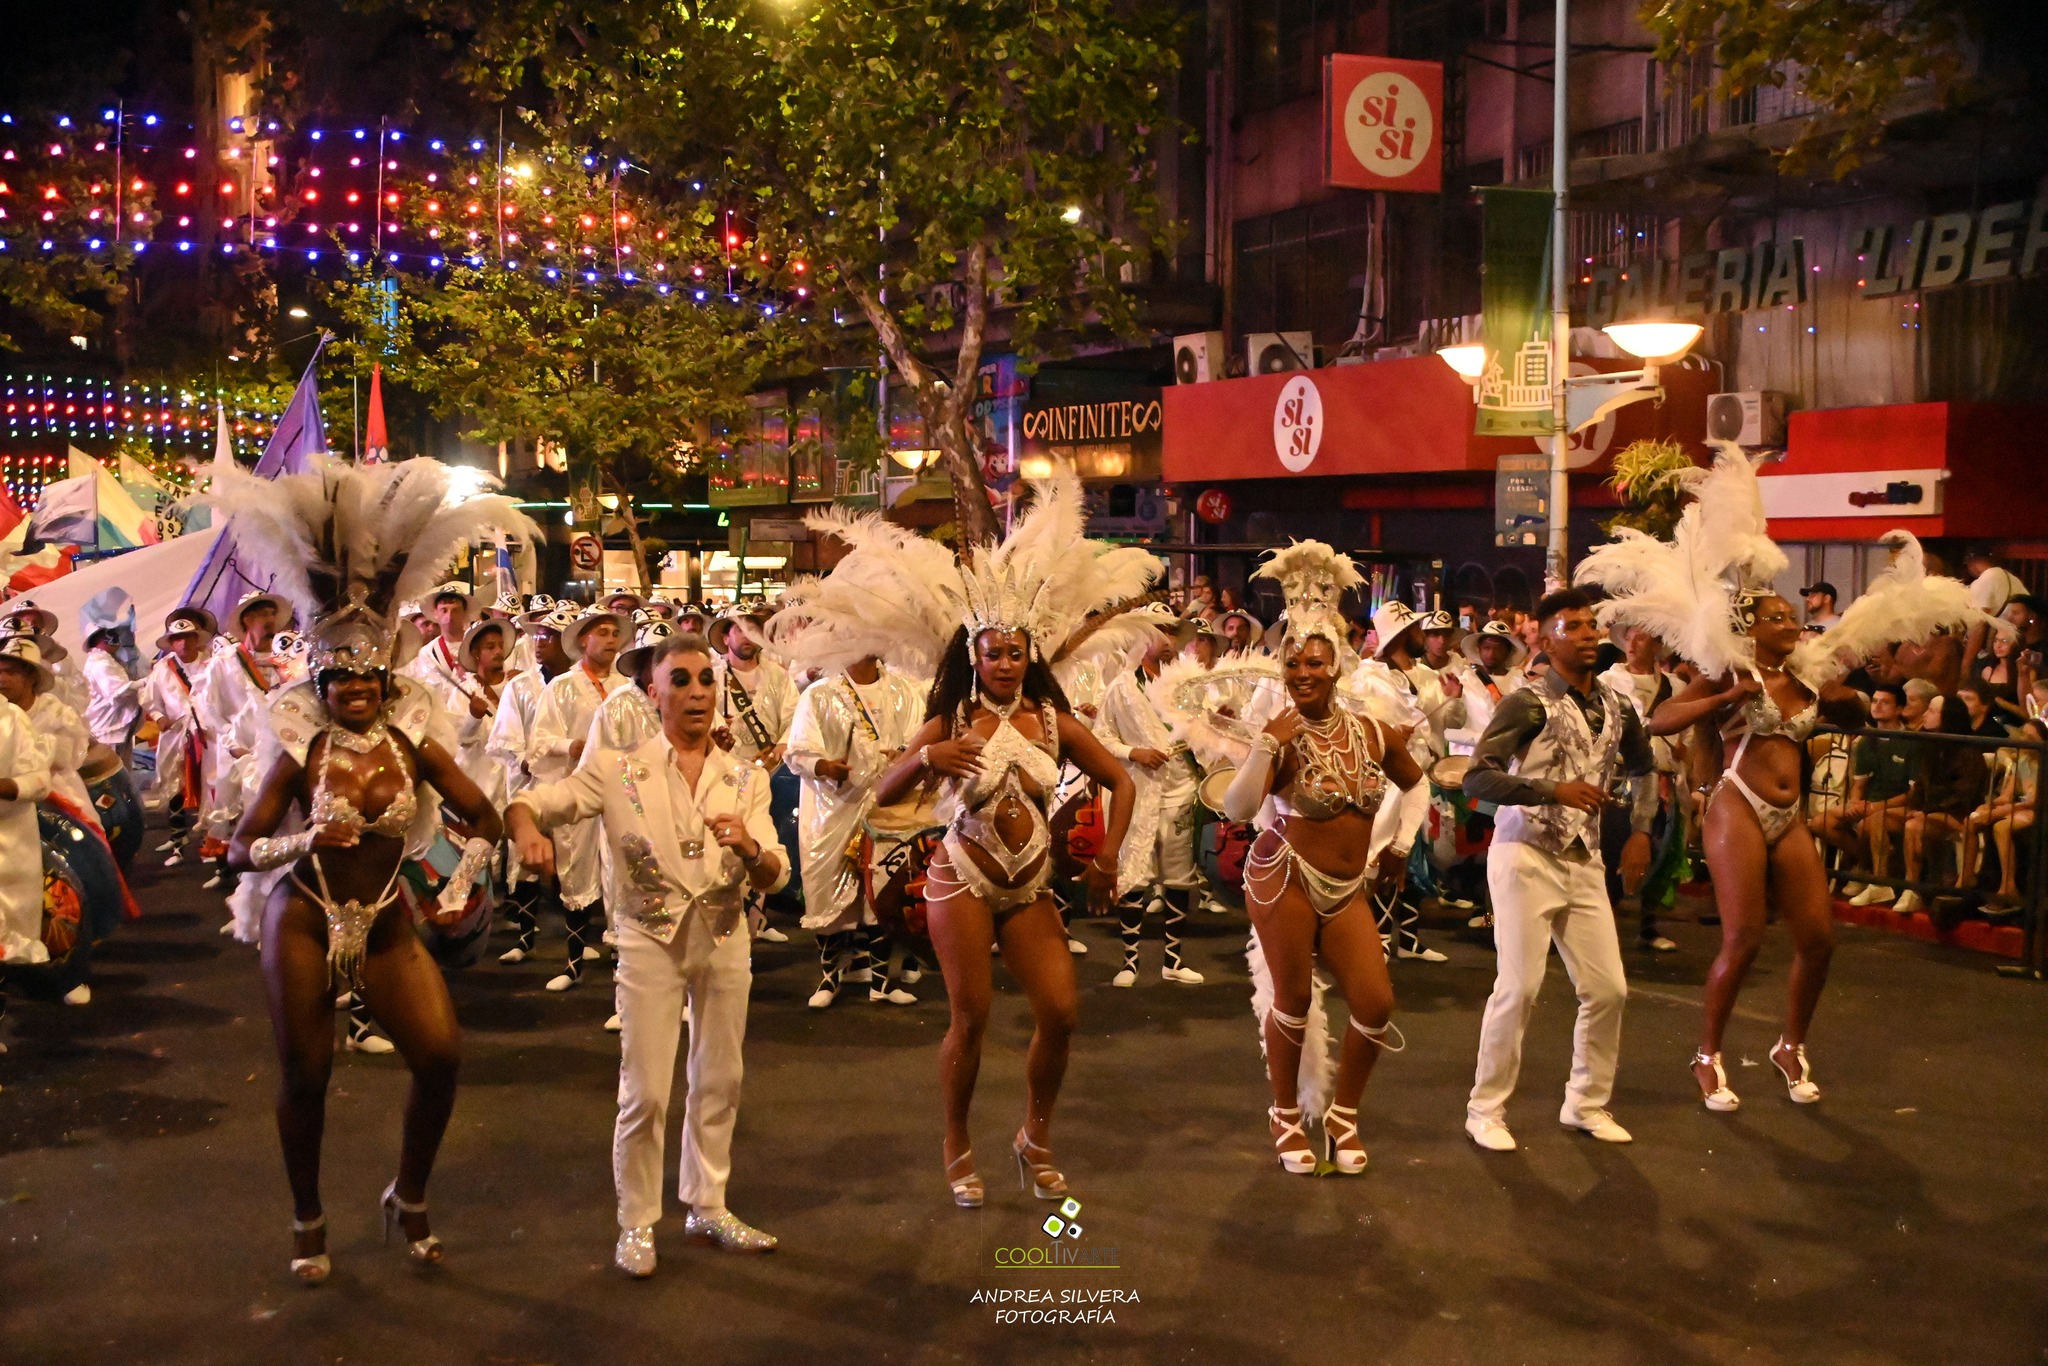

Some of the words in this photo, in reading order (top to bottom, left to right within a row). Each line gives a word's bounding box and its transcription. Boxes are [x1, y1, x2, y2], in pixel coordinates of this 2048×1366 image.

[1359, 84, 1399, 127] si
[1376, 118, 1416, 160] si
[1586, 236, 1808, 330] GALERIA
[1281, 386, 1305, 427] si
[1290, 415, 1313, 456] si
